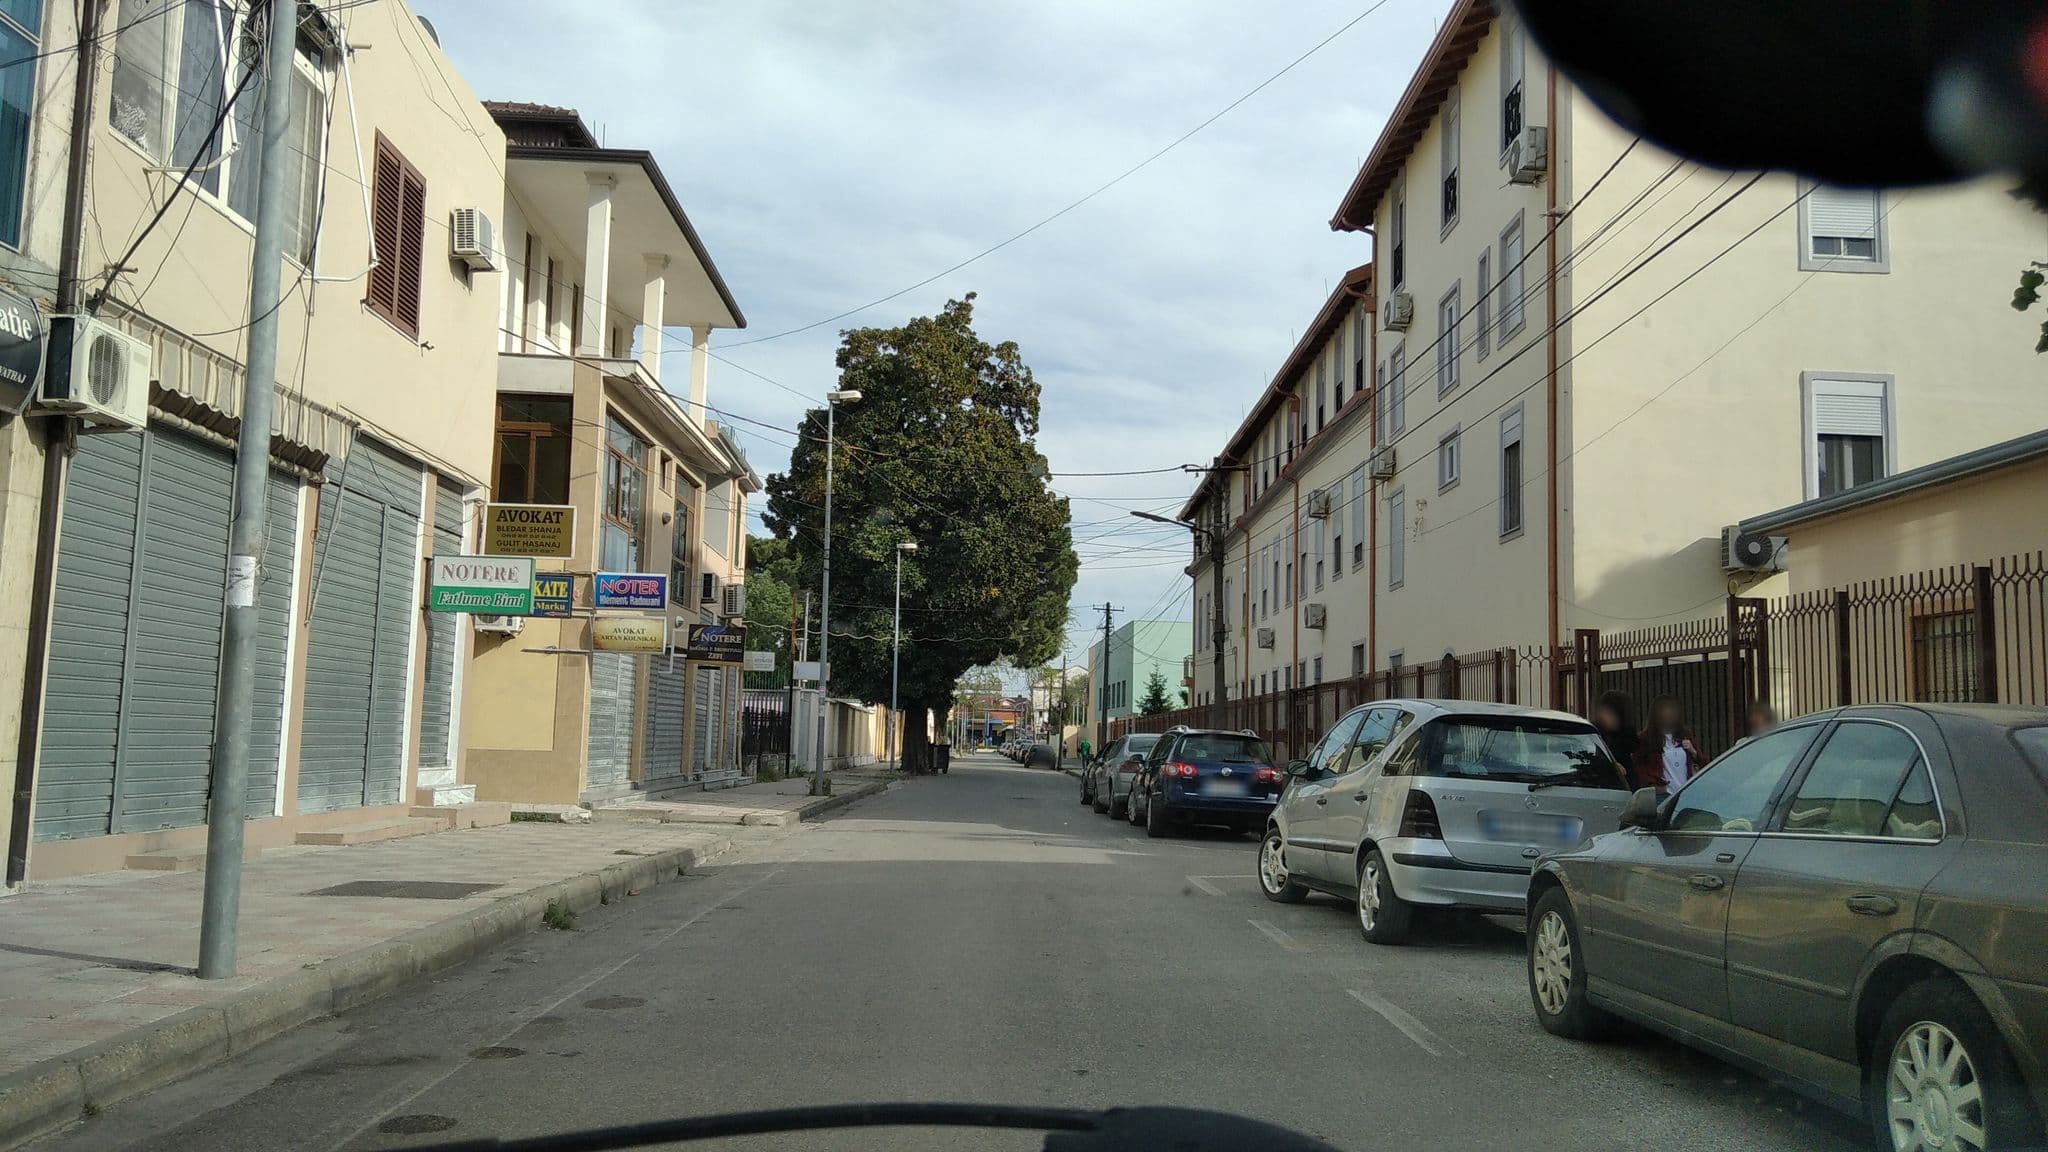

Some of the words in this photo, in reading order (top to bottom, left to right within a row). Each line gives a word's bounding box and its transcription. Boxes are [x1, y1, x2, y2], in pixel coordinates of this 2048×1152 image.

[496, 509, 563, 524] AVOKAT
[496, 525, 527, 533] BLEDAR
[529, 526, 562, 534] SHANJA
[522, 541, 561, 549] HASANAJ
[441, 563, 520, 583] NOTERE
[533, 580, 568, 598] KATE
[600, 578, 660, 595] NOTER
[437, 591, 492, 606] Fatlume
[492, 592, 525, 608] Bimi
[535, 602, 566, 610] Marku
[612, 627, 646, 635] AVOKAT
[701, 632, 742, 643] NOTERE
